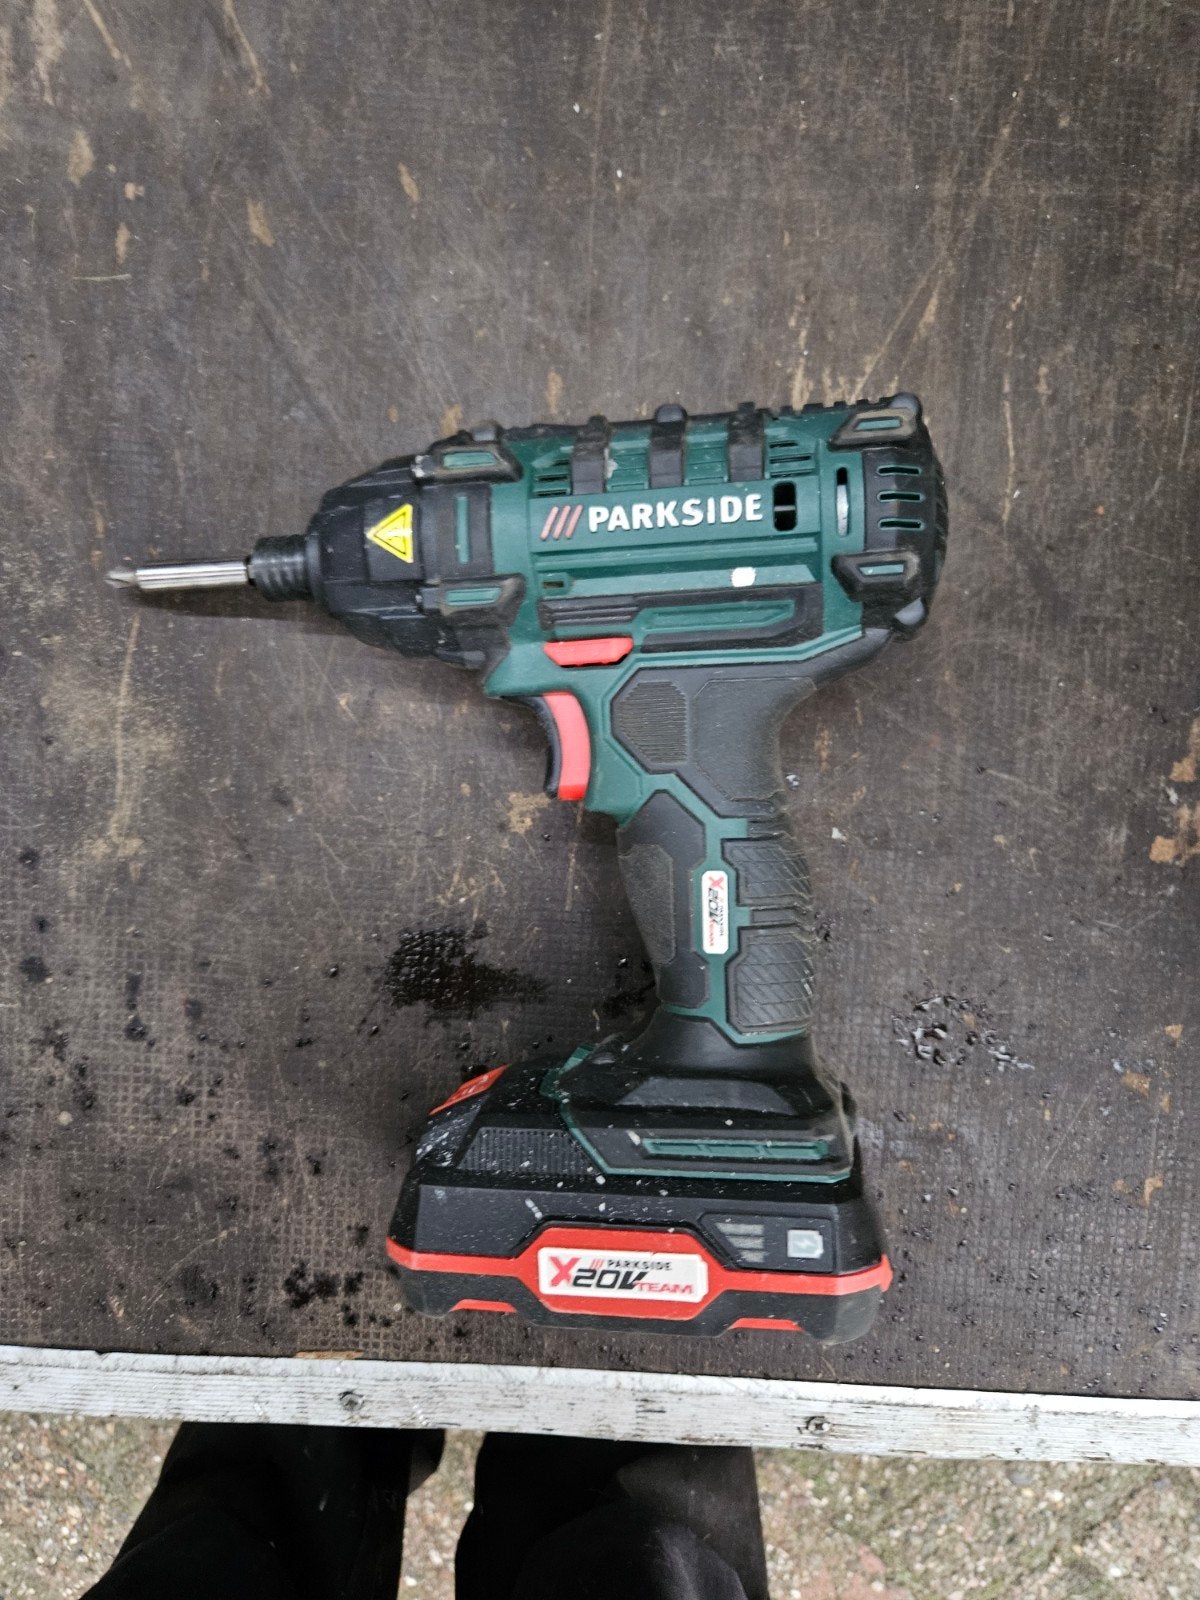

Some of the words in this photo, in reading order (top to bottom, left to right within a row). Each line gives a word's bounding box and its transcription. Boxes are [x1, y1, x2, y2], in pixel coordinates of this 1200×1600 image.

[588, 493, 763, 533] PARKSIDE
[607, 1259, 673, 1271] PARKSIDE
[634, 1281, 694, 1295] TEAM
